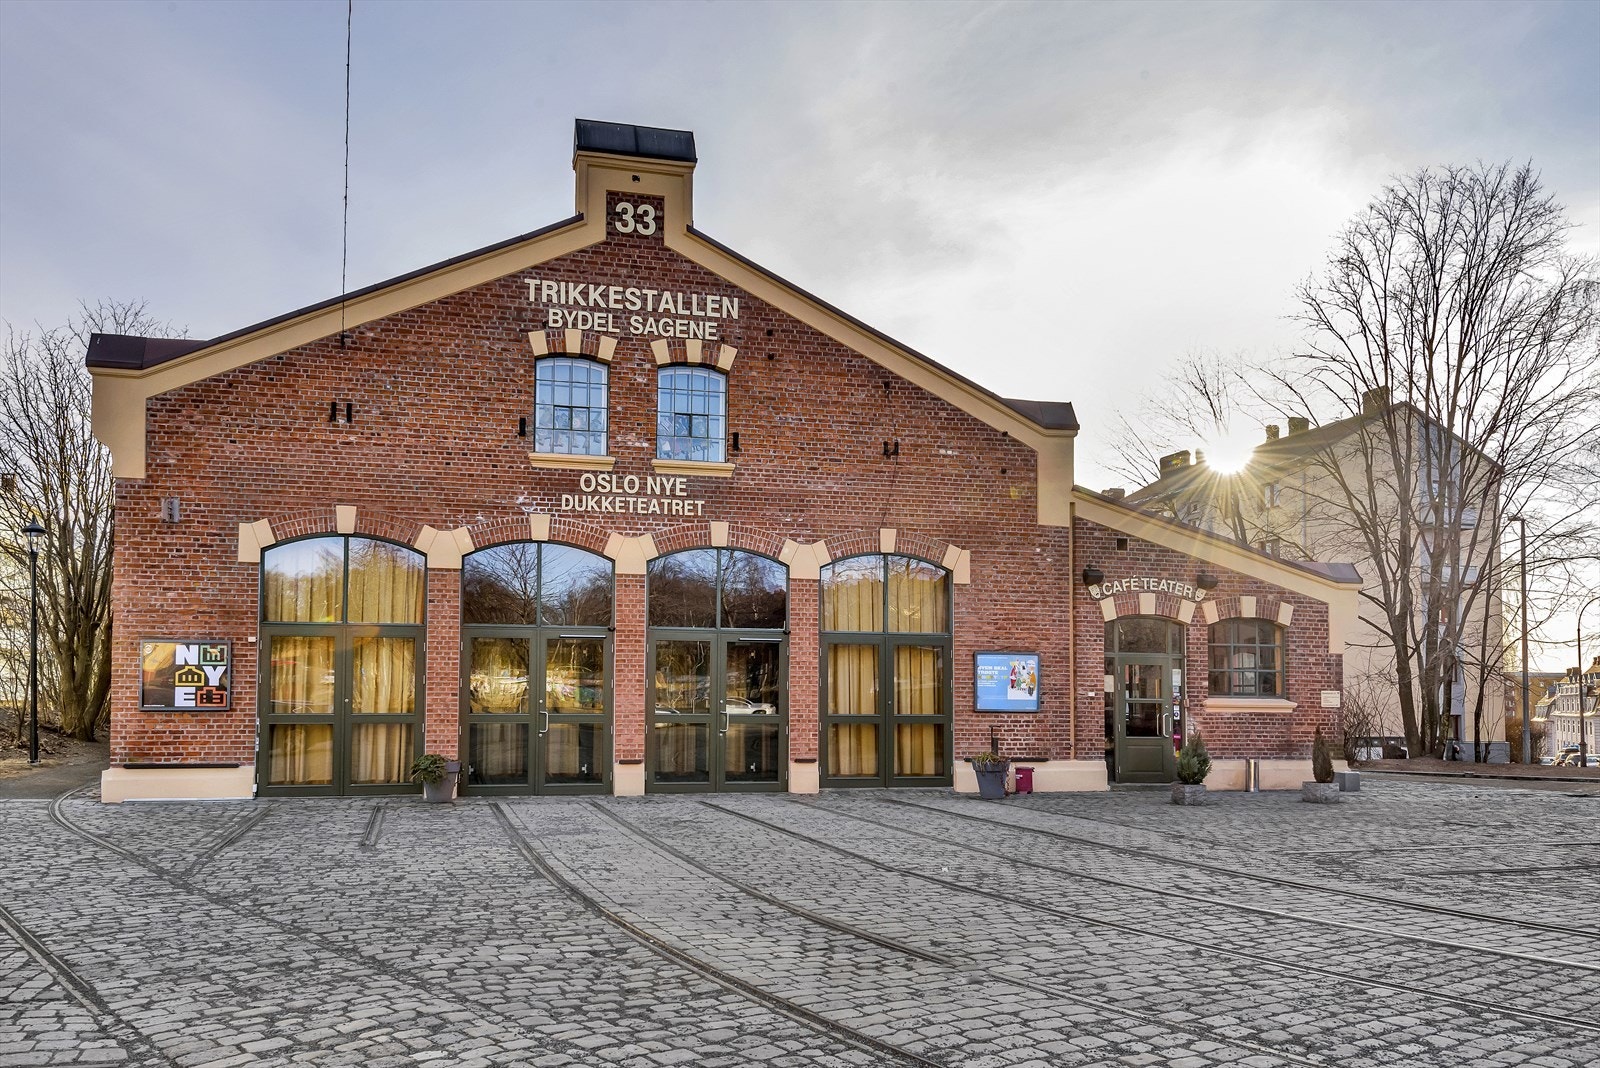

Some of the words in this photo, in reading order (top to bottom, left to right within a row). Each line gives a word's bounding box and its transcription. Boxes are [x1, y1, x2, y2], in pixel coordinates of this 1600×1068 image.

[615, 202, 656, 236] 33
[524, 278, 739, 320] TRIKKESTALLEN
[548, 309, 620, 334] BYDEL
[629, 315, 718, 341] SAGENE
[580, 473, 640, 495] OSLO
[647, 477, 688, 497] NYE
[561, 494, 705, 517] DUKKETEATRET
[1102, 575, 1139, 595] CAFÉ
[1141, 577, 1193, 599] TEATER
